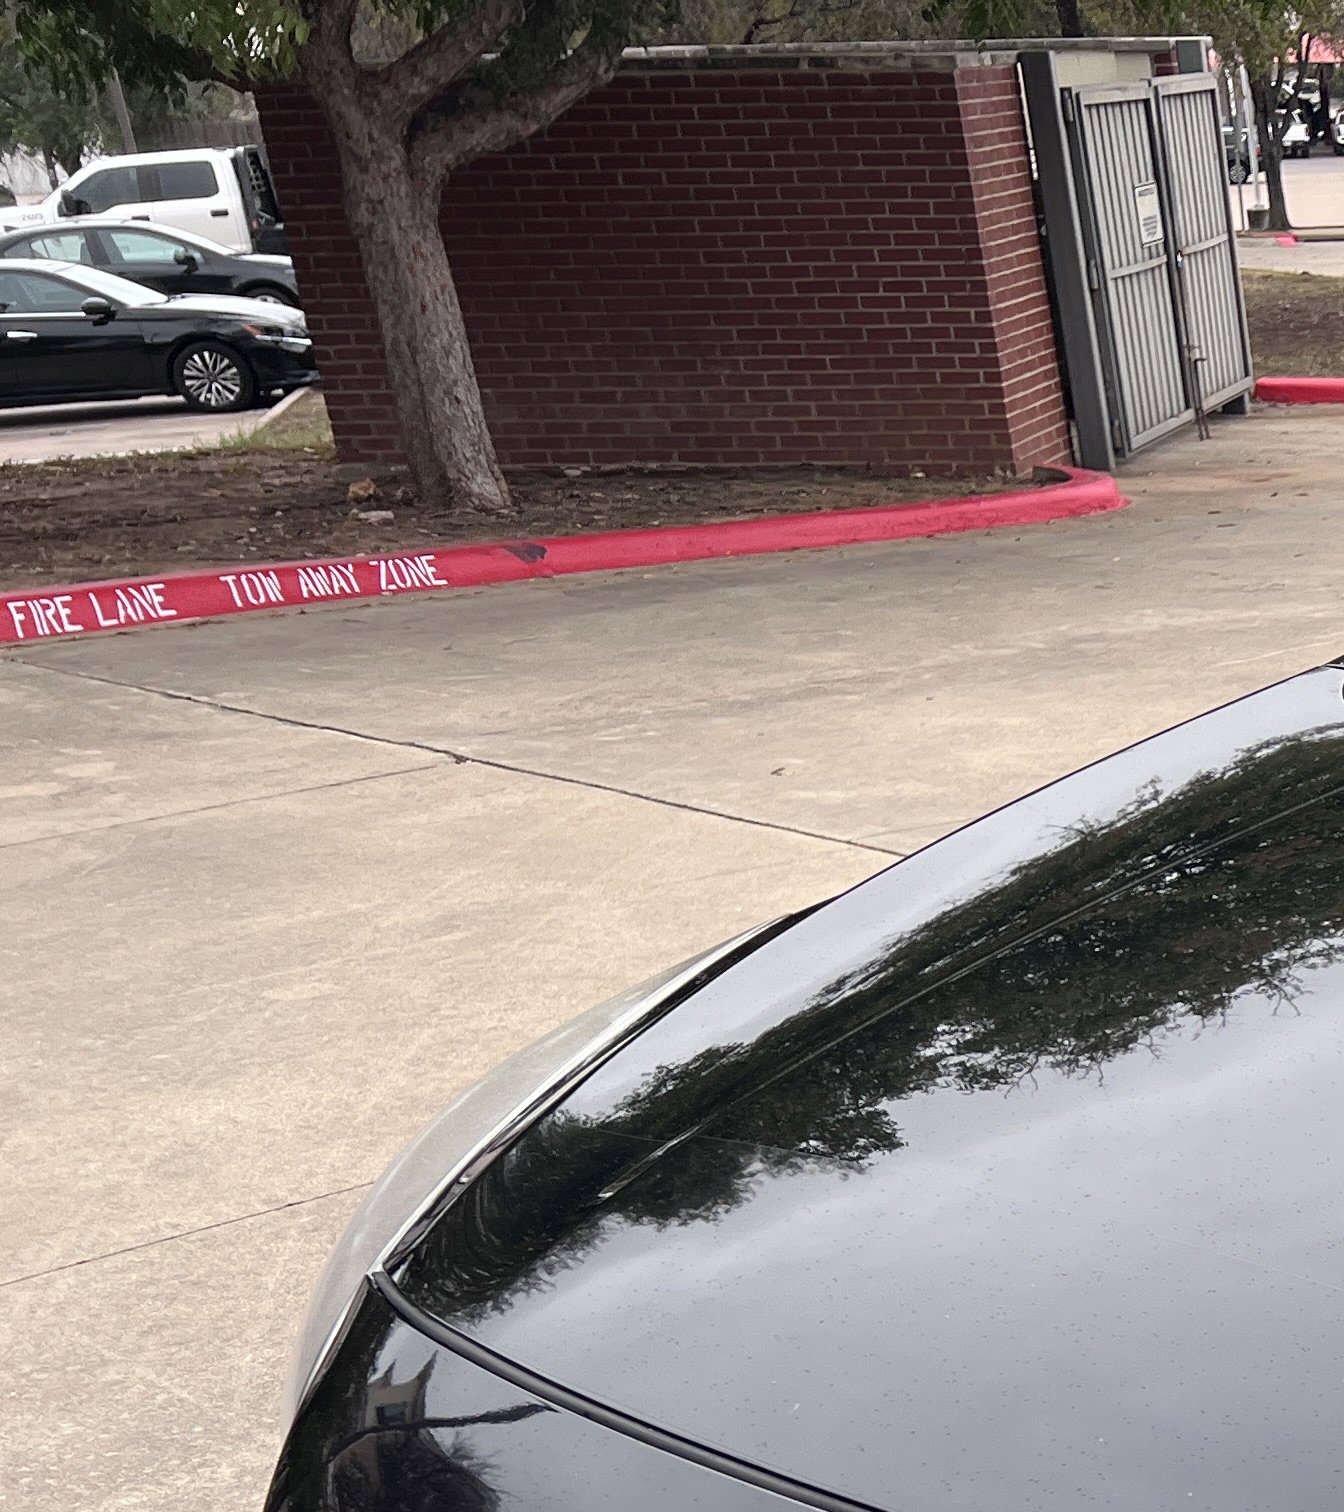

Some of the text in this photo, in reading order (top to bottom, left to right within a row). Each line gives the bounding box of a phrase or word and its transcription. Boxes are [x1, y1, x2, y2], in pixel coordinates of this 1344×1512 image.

[7, 554, 449, 639] FIRE LANE TOW AWAY ZONE
